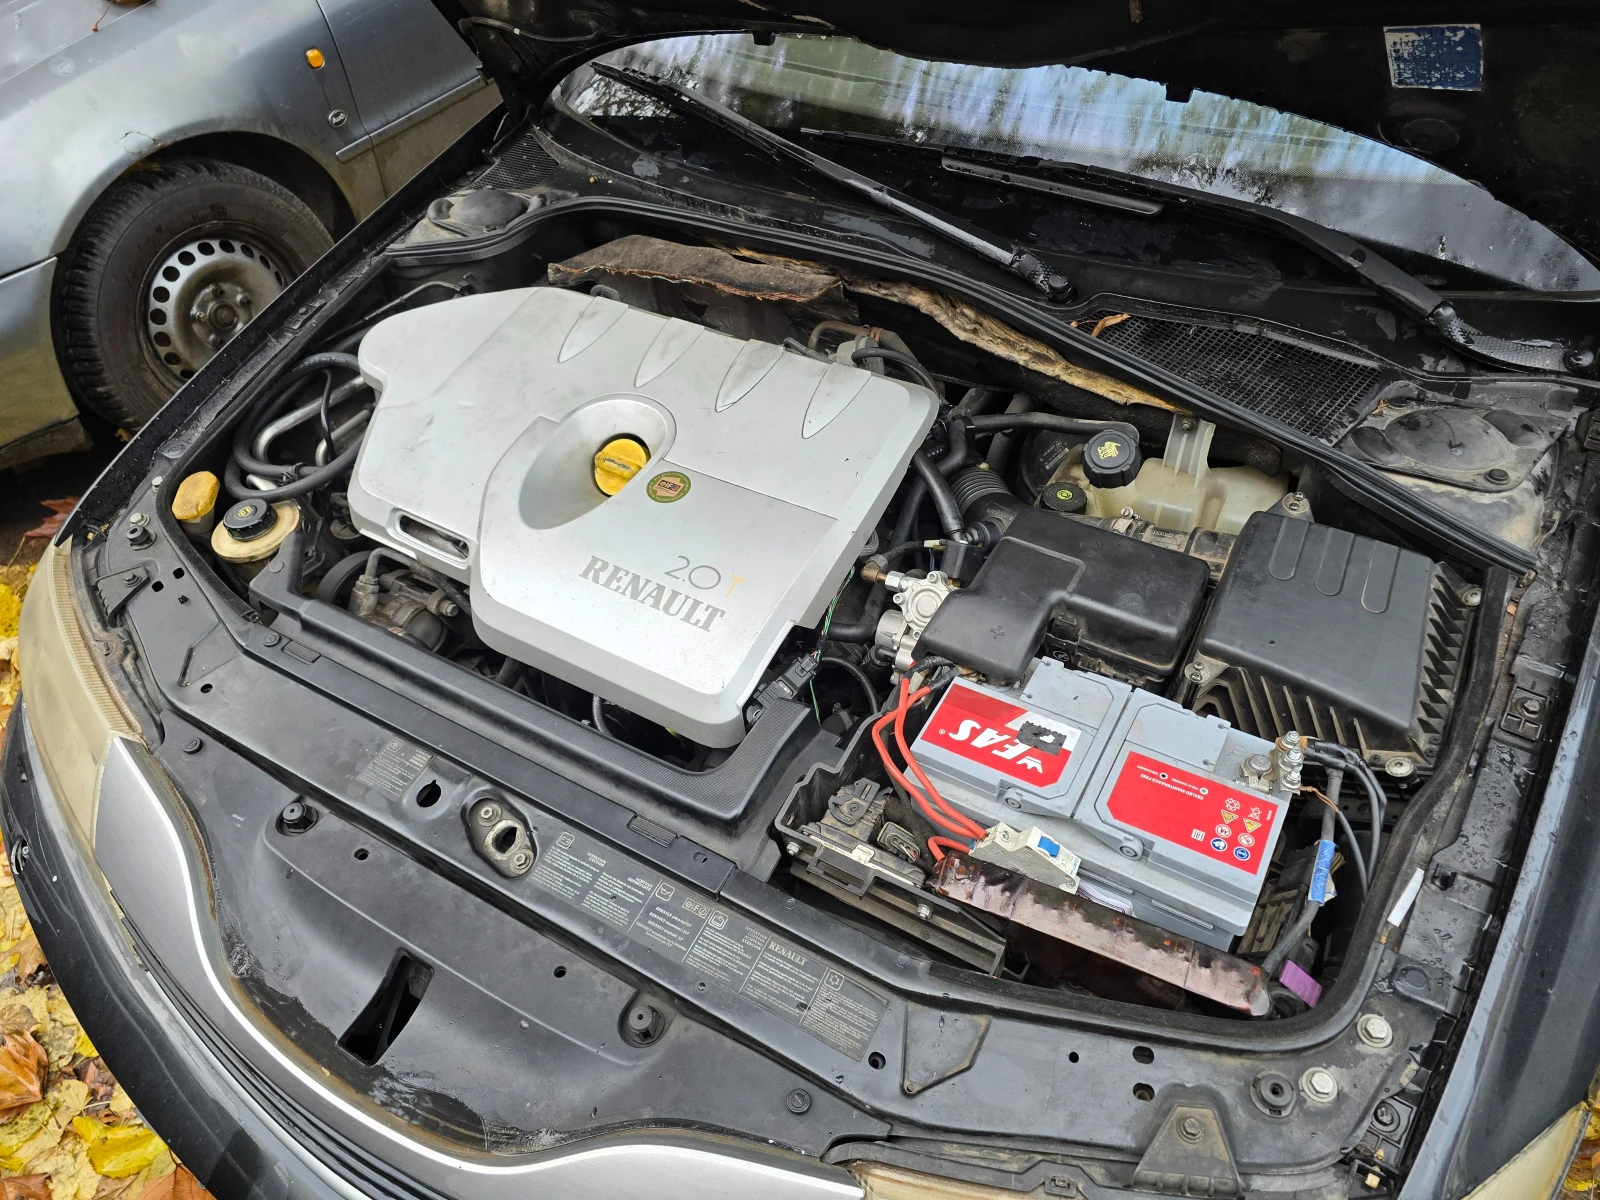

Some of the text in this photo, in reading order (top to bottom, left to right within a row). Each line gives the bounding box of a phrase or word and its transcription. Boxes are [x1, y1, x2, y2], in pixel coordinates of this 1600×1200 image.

[578, 555, 727, 632] RENAULT
[1152, 778, 1186, 793] MAINTENANCE
[1186, 790, 1204, 800] SEALED
[768, 940, 807, 966] RENAULT
